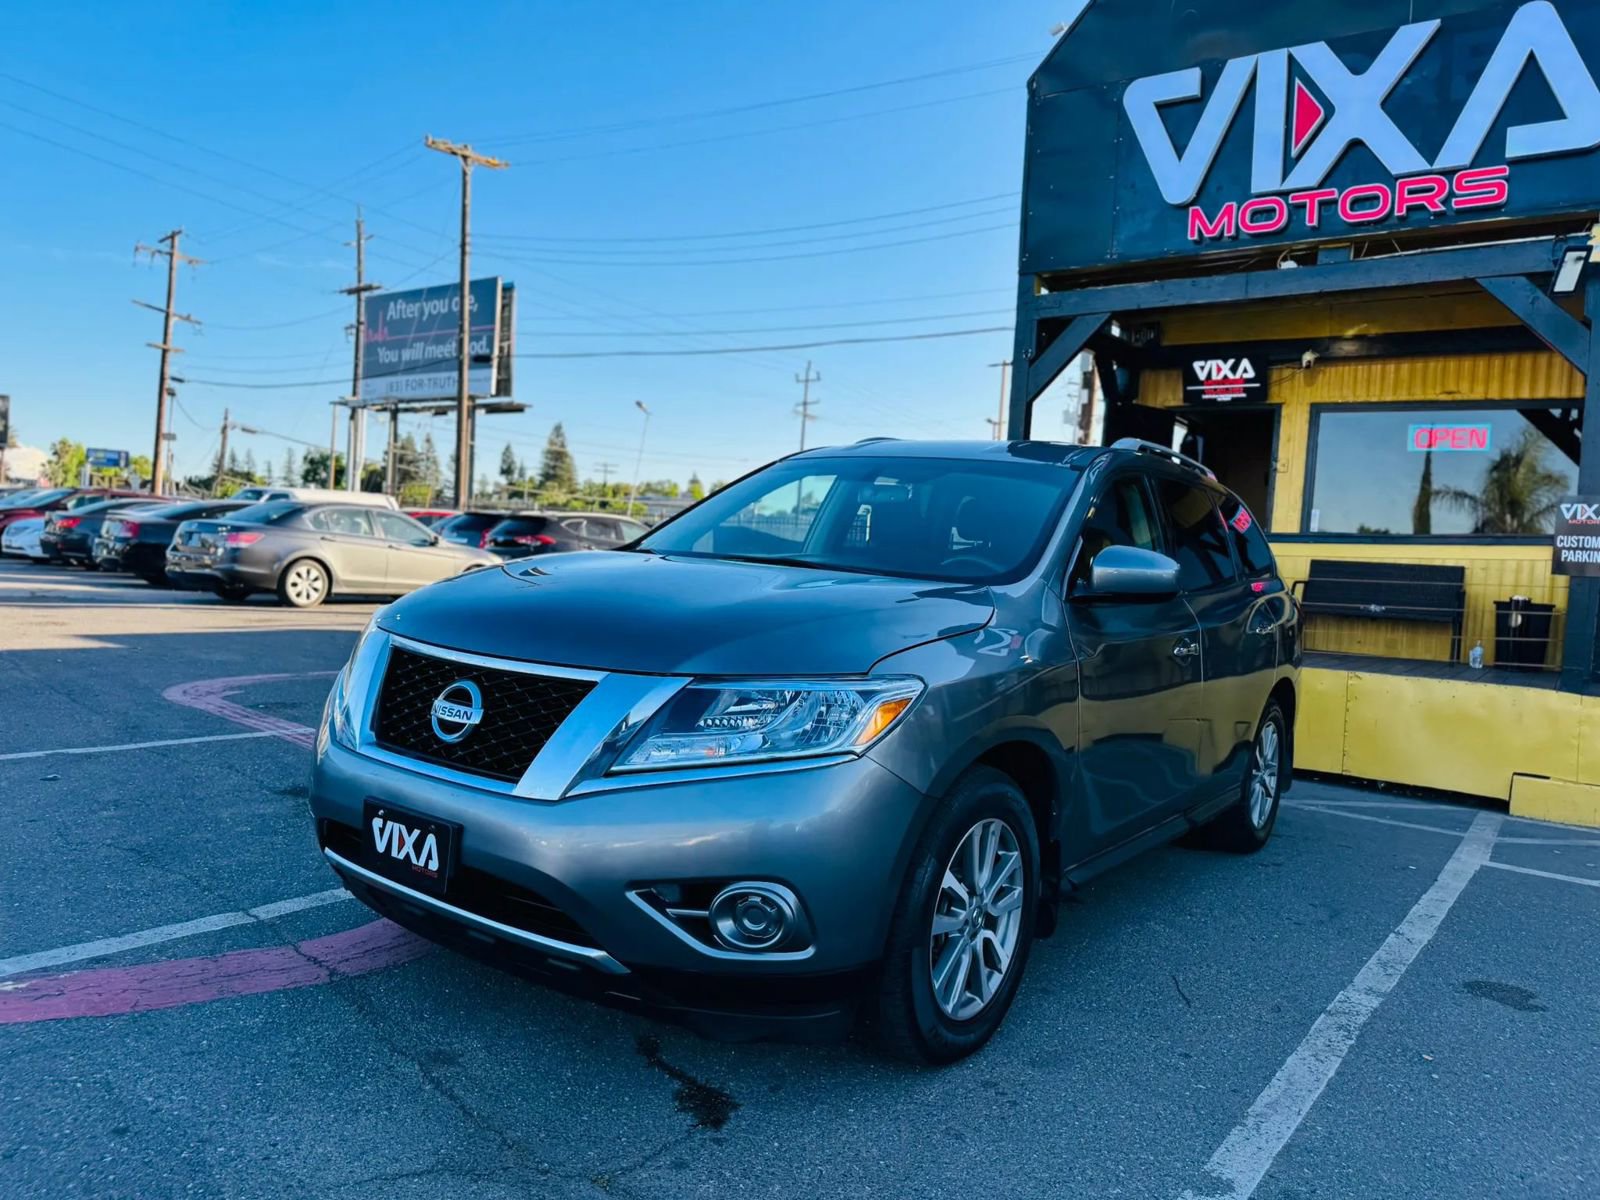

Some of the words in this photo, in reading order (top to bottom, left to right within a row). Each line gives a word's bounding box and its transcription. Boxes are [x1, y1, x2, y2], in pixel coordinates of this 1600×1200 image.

[1123, 0, 1600, 206] VIXA
[1187, 165, 1510, 241] MOTORS
[386, 299, 420, 321] After
[422, 299, 449, 322] you
[377, 345, 399, 364] You
[402, 341, 425, 361] will
[425, 340, 457, 359] meet
[1192, 357, 1256, 381] VIXA
[1414, 427, 1488, 449] OPEN
[1560, 503, 1600, 520] VIX
[434, 703, 473, 721] NISSAN
[372, 816, 439, 872] VIXA
